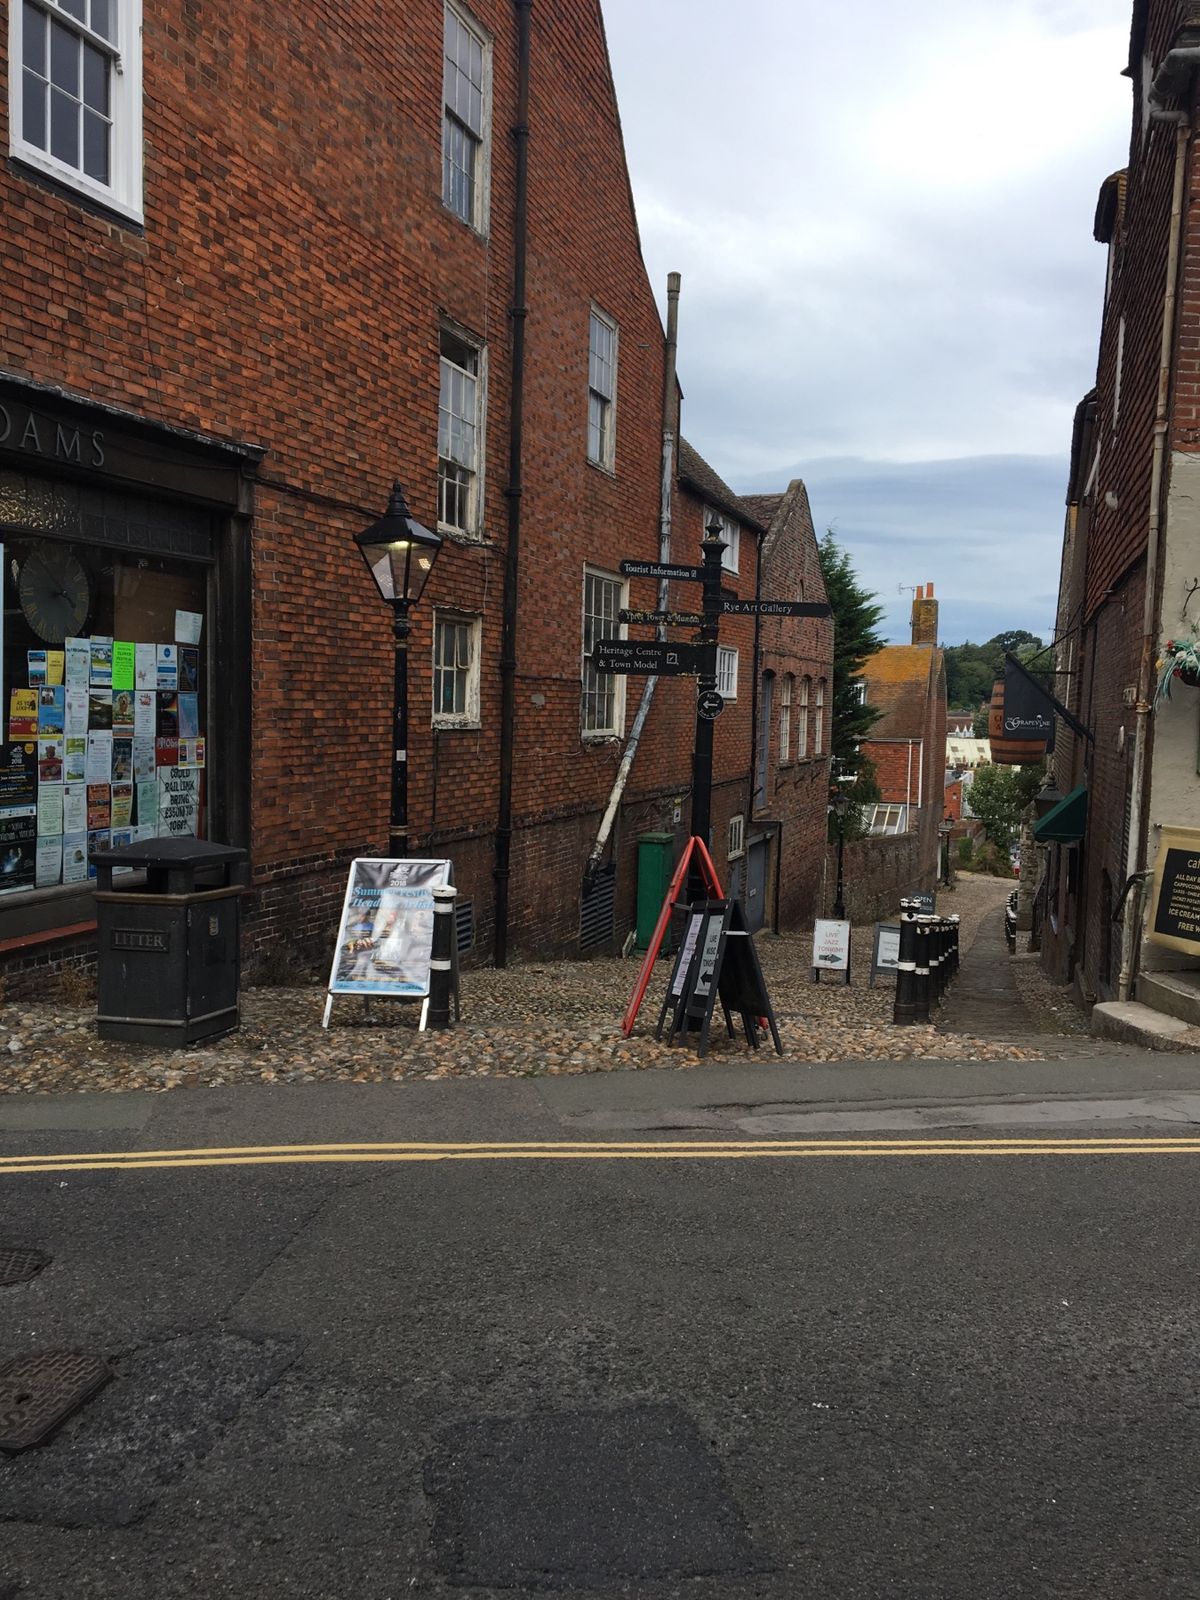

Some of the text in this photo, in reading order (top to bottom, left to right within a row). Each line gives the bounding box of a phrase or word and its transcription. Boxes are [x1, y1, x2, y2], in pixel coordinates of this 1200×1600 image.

[624, 563, 689, 577] Tourist Information
[723, 602, 792, 614] Rye Art Gallery
[599, 645, 662, 657] Heritage Centre
[609, 660, 631, 668] Town
[633, 660, 658, 669] Model
[170, 768, 190, 778] COULD
[165, 781, 179, 792] RAIL
[170, 794, 190, 805] BRING
[1186, 874, 1197, 882] DAY
[914, 895, 933, 903] OPEN
[1168, 907, 1200, 920] ICE CREAM
[1178, 921, 1195, 932] FREE
[115, 932, 164, 947] LITTER
